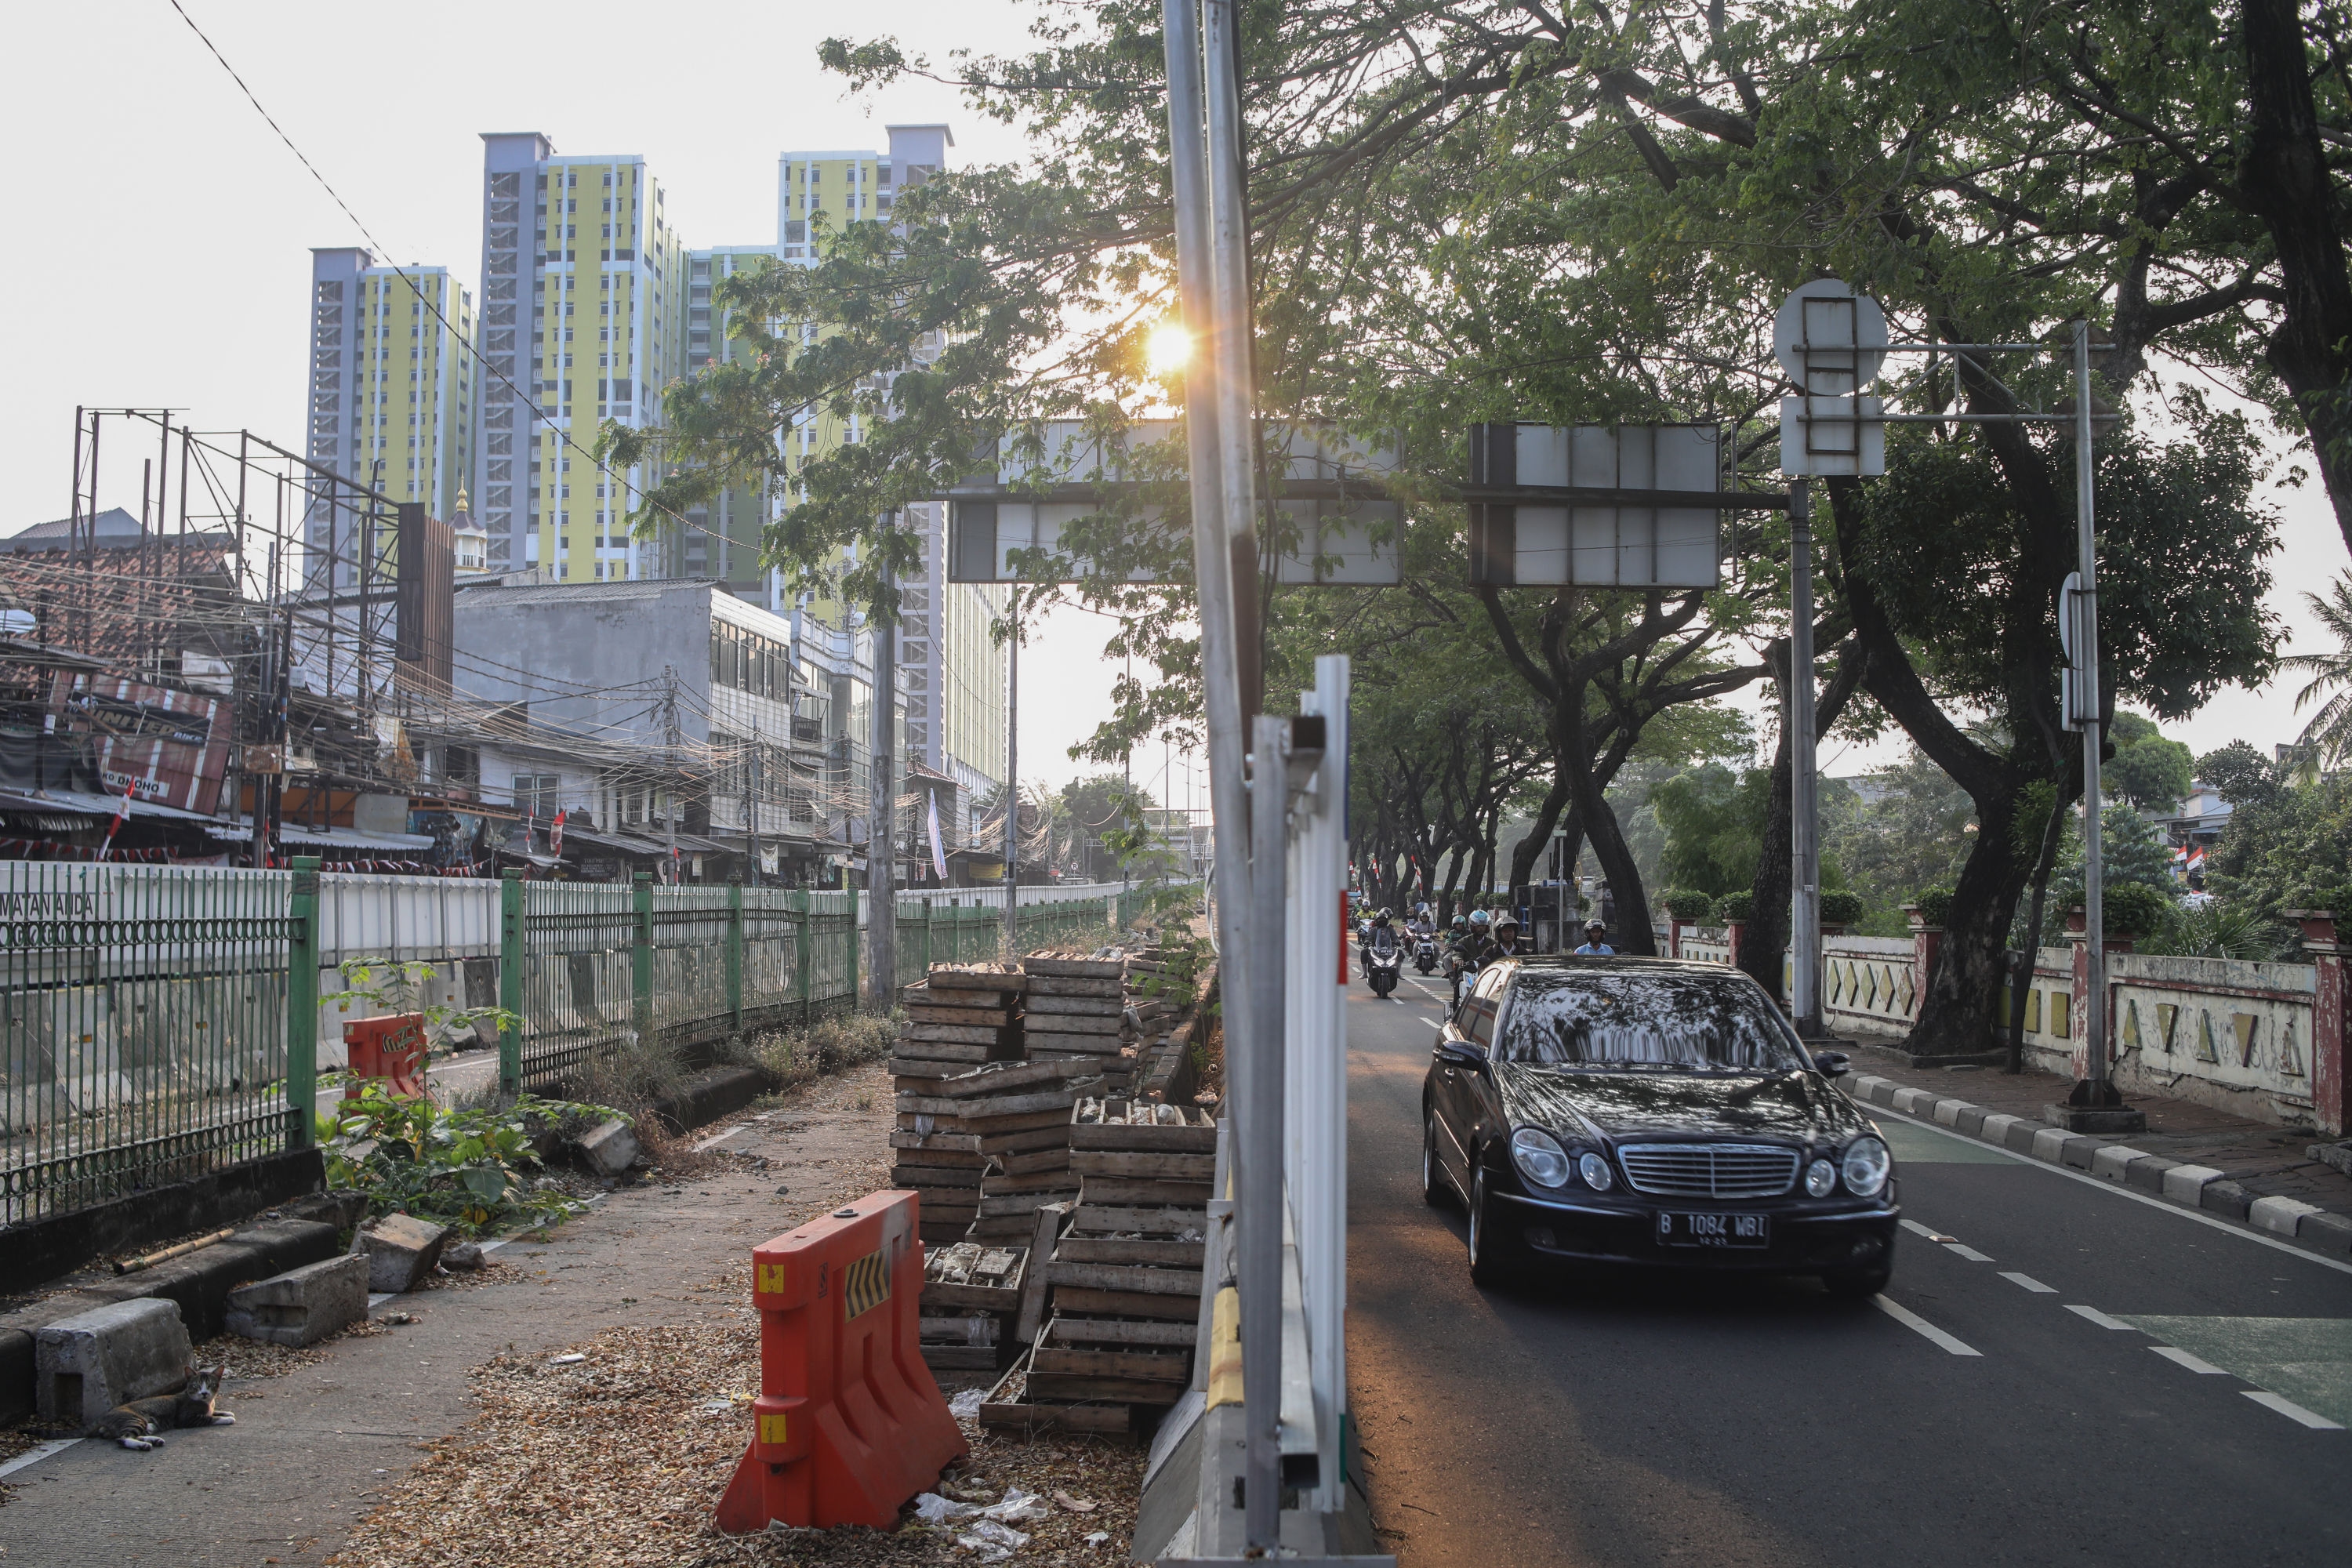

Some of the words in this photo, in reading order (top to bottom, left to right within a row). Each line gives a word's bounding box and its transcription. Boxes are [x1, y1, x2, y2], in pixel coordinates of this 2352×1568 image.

[56, 894, 93, 915] ANDA
[1661, 1214, 1671, 1234] B
[1688, 1214, 1727, 1235] 1084
[1735, 1216, 1765, 1236] WBI
